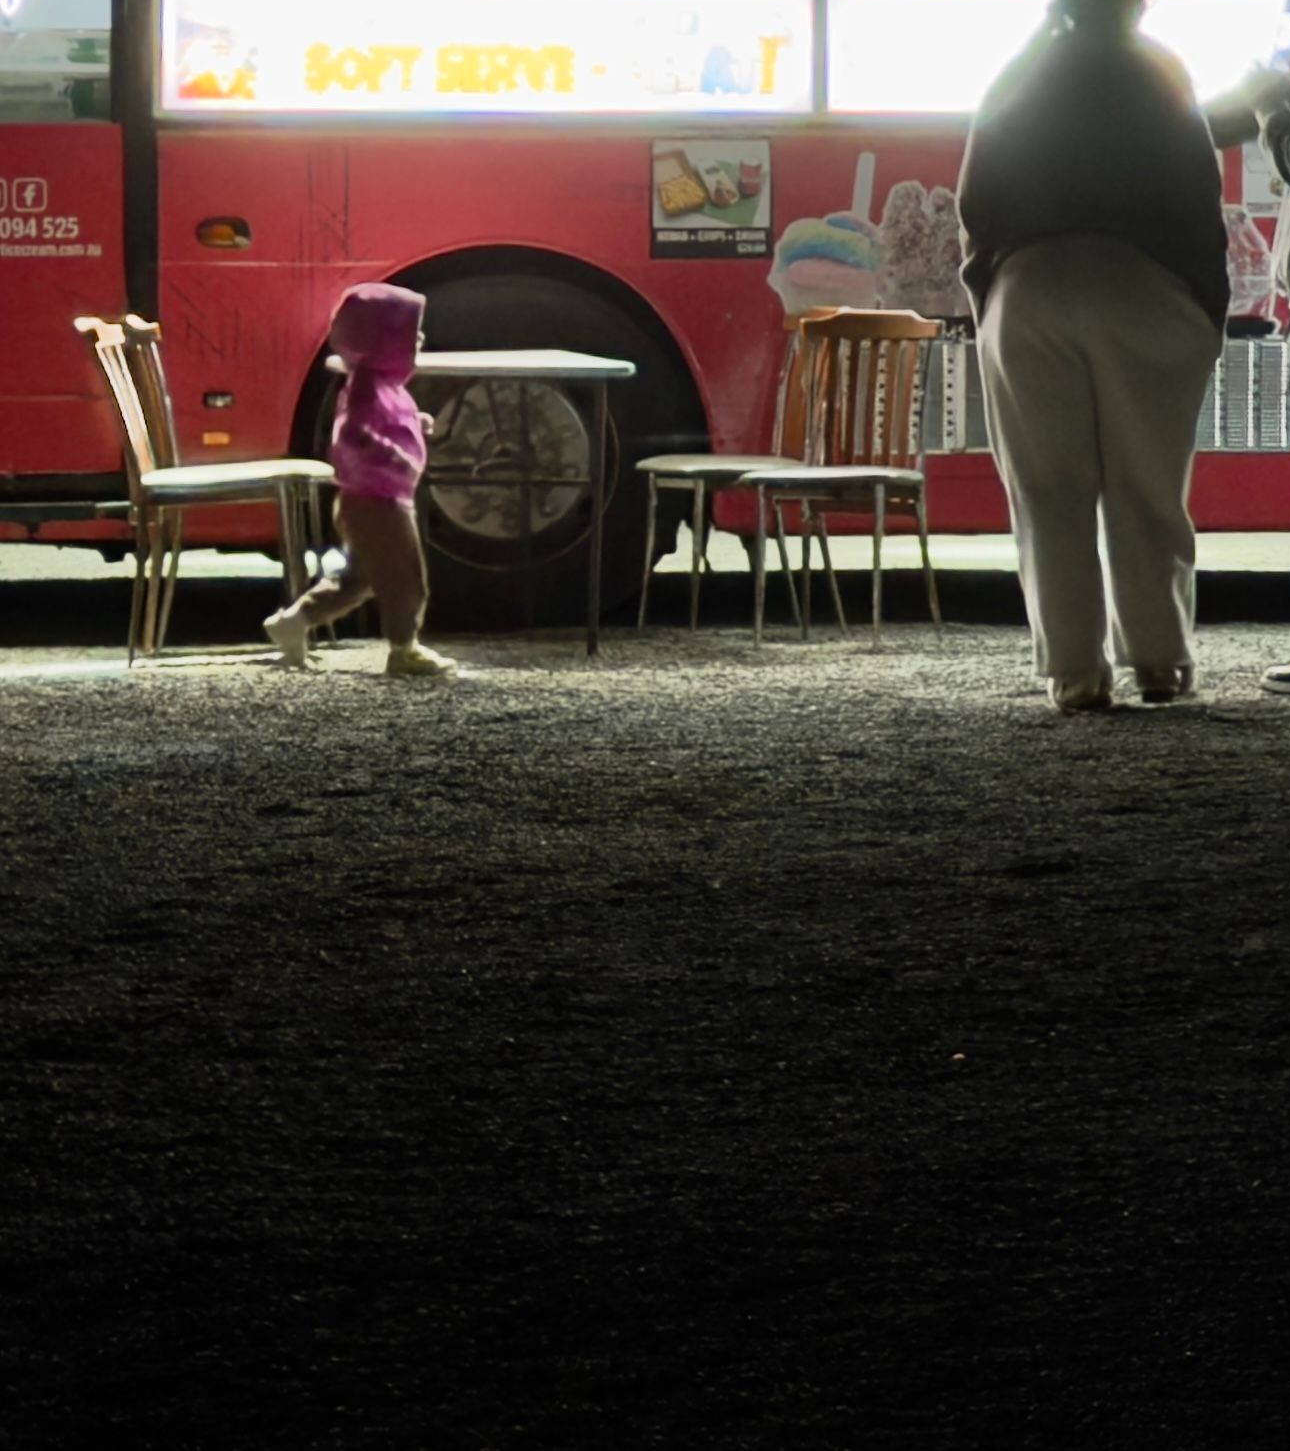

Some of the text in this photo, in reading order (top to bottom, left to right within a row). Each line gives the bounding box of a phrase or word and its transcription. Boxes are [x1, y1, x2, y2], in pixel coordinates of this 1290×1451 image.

[304, 42, 424, 93] SOFT
[0, 217, 80, 239] 094 525
